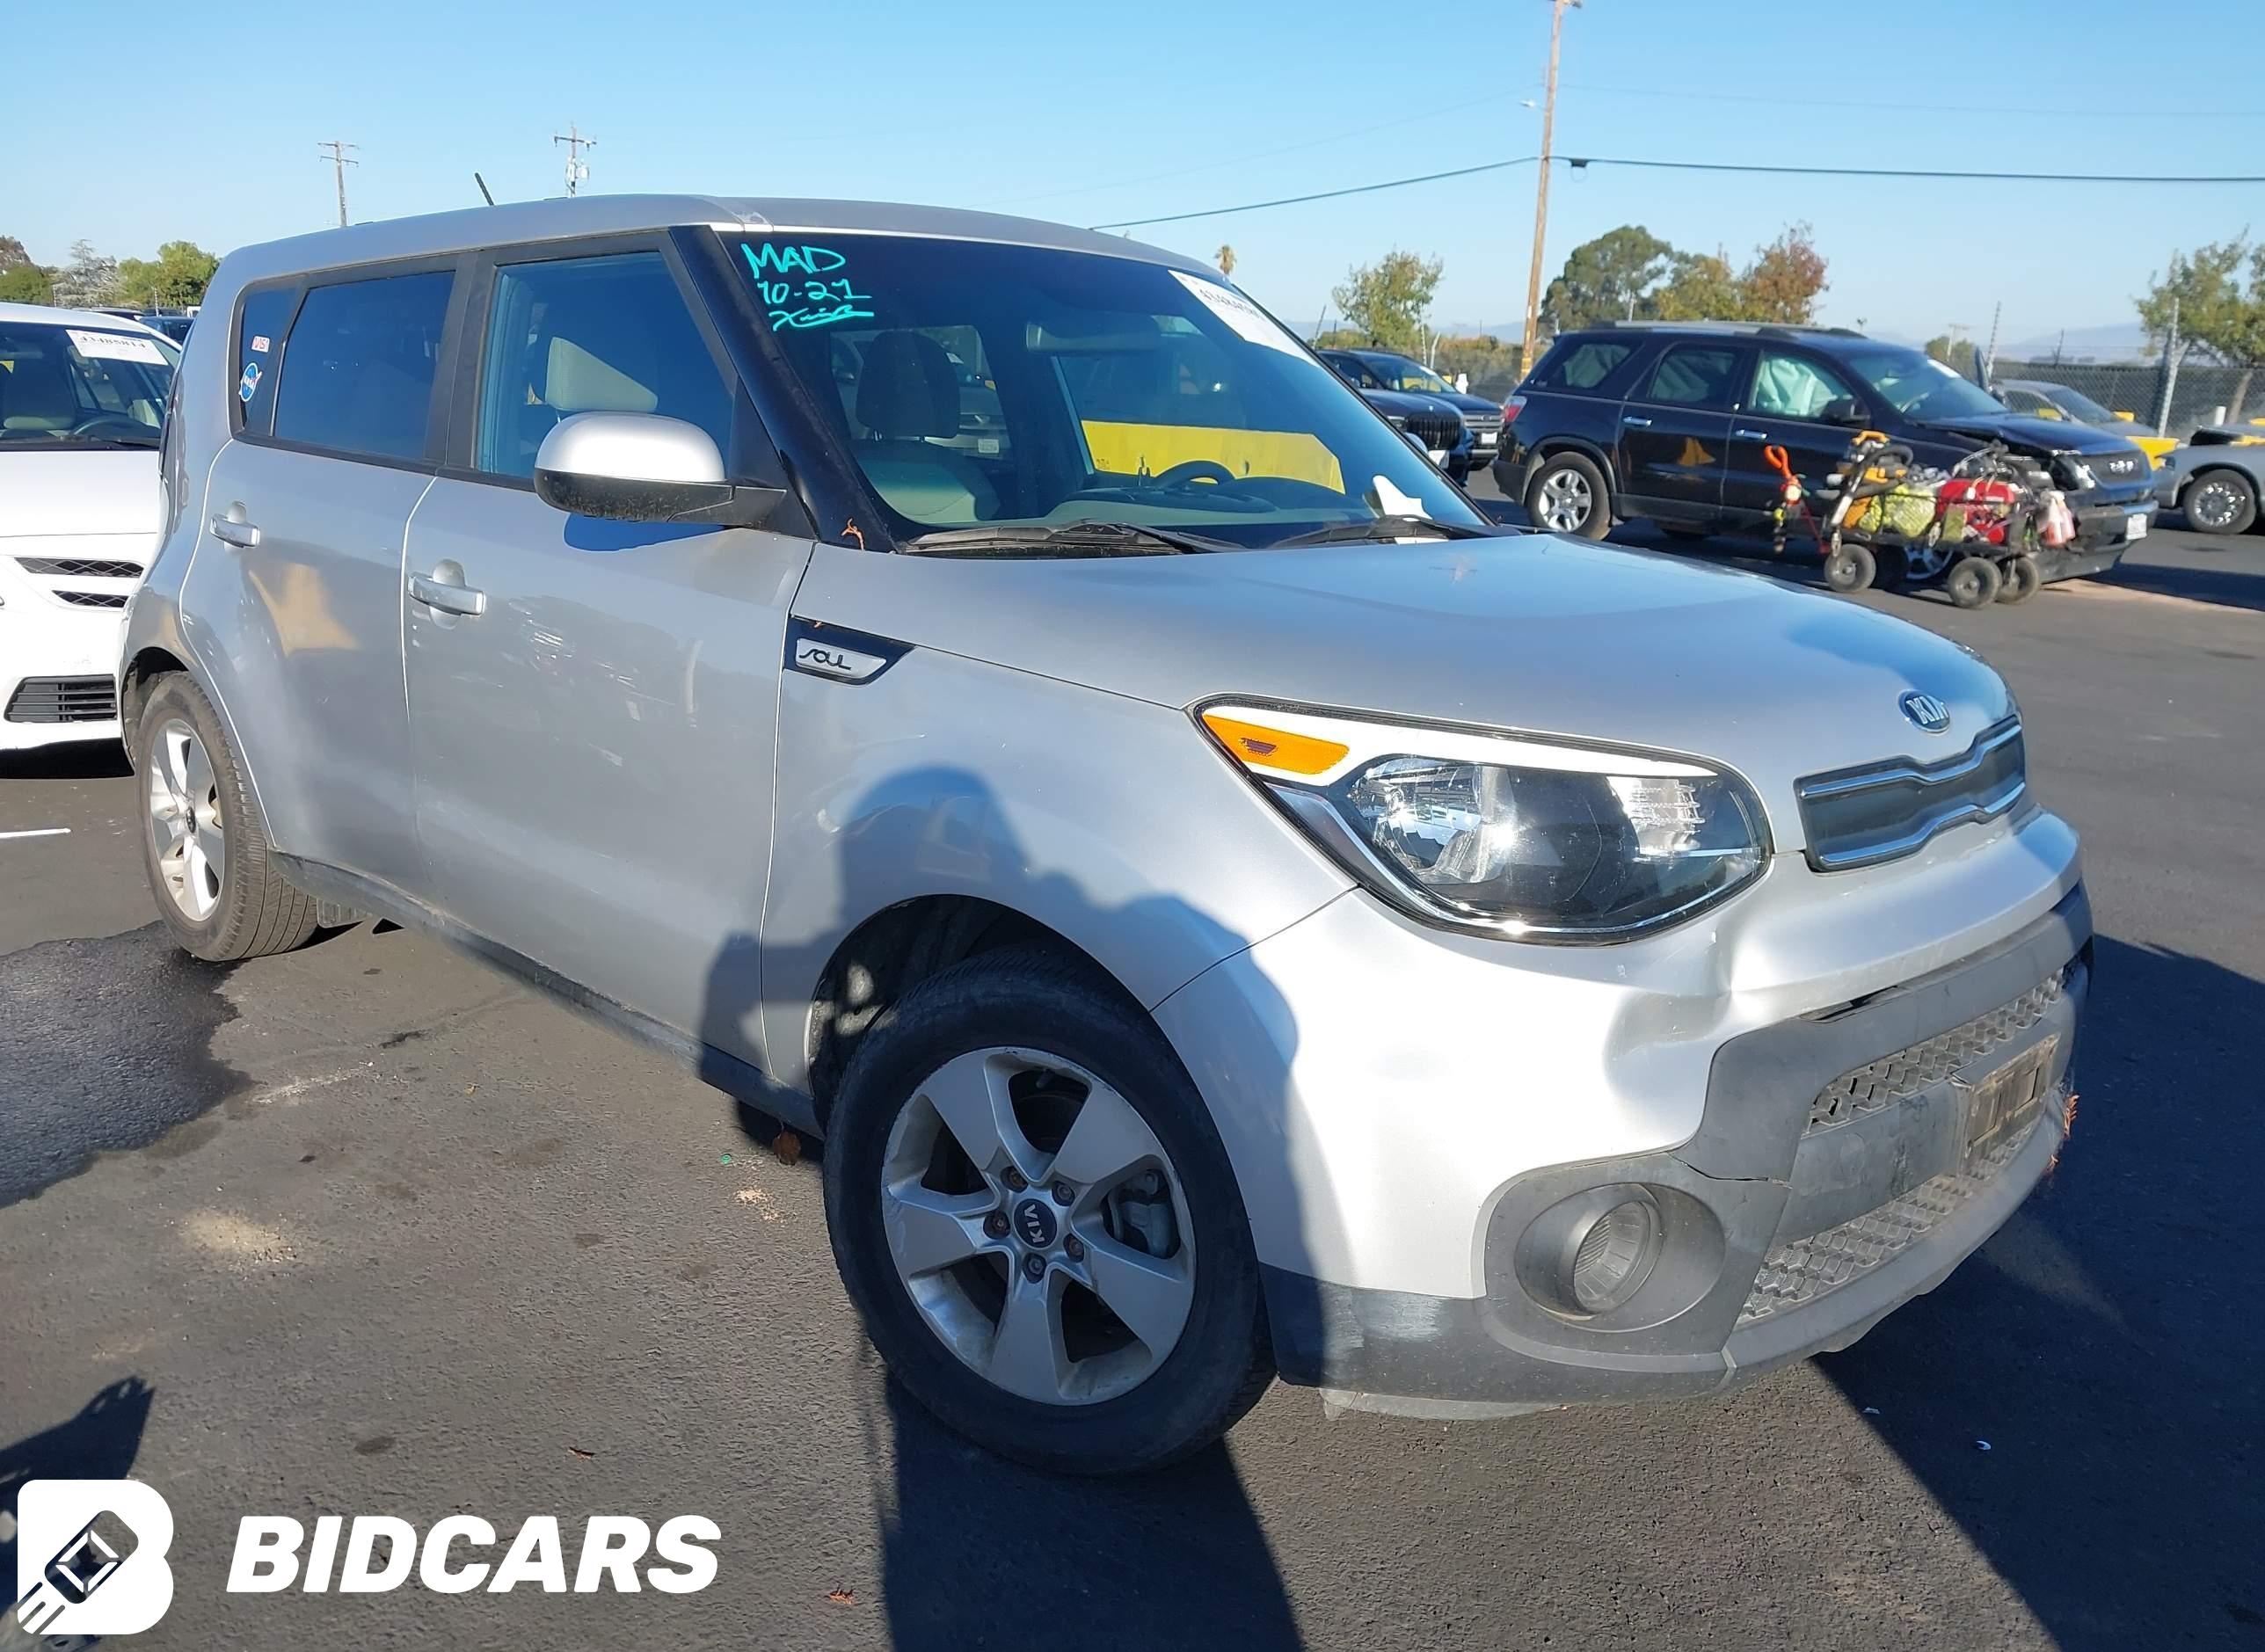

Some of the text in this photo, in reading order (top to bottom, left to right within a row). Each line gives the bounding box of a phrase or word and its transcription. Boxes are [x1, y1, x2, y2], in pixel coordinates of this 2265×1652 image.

[741, 243, 846, 279] MAD
[1905, 695, 1948, 724] KIA
[1024, 1204, 1045, 1243] KIA
